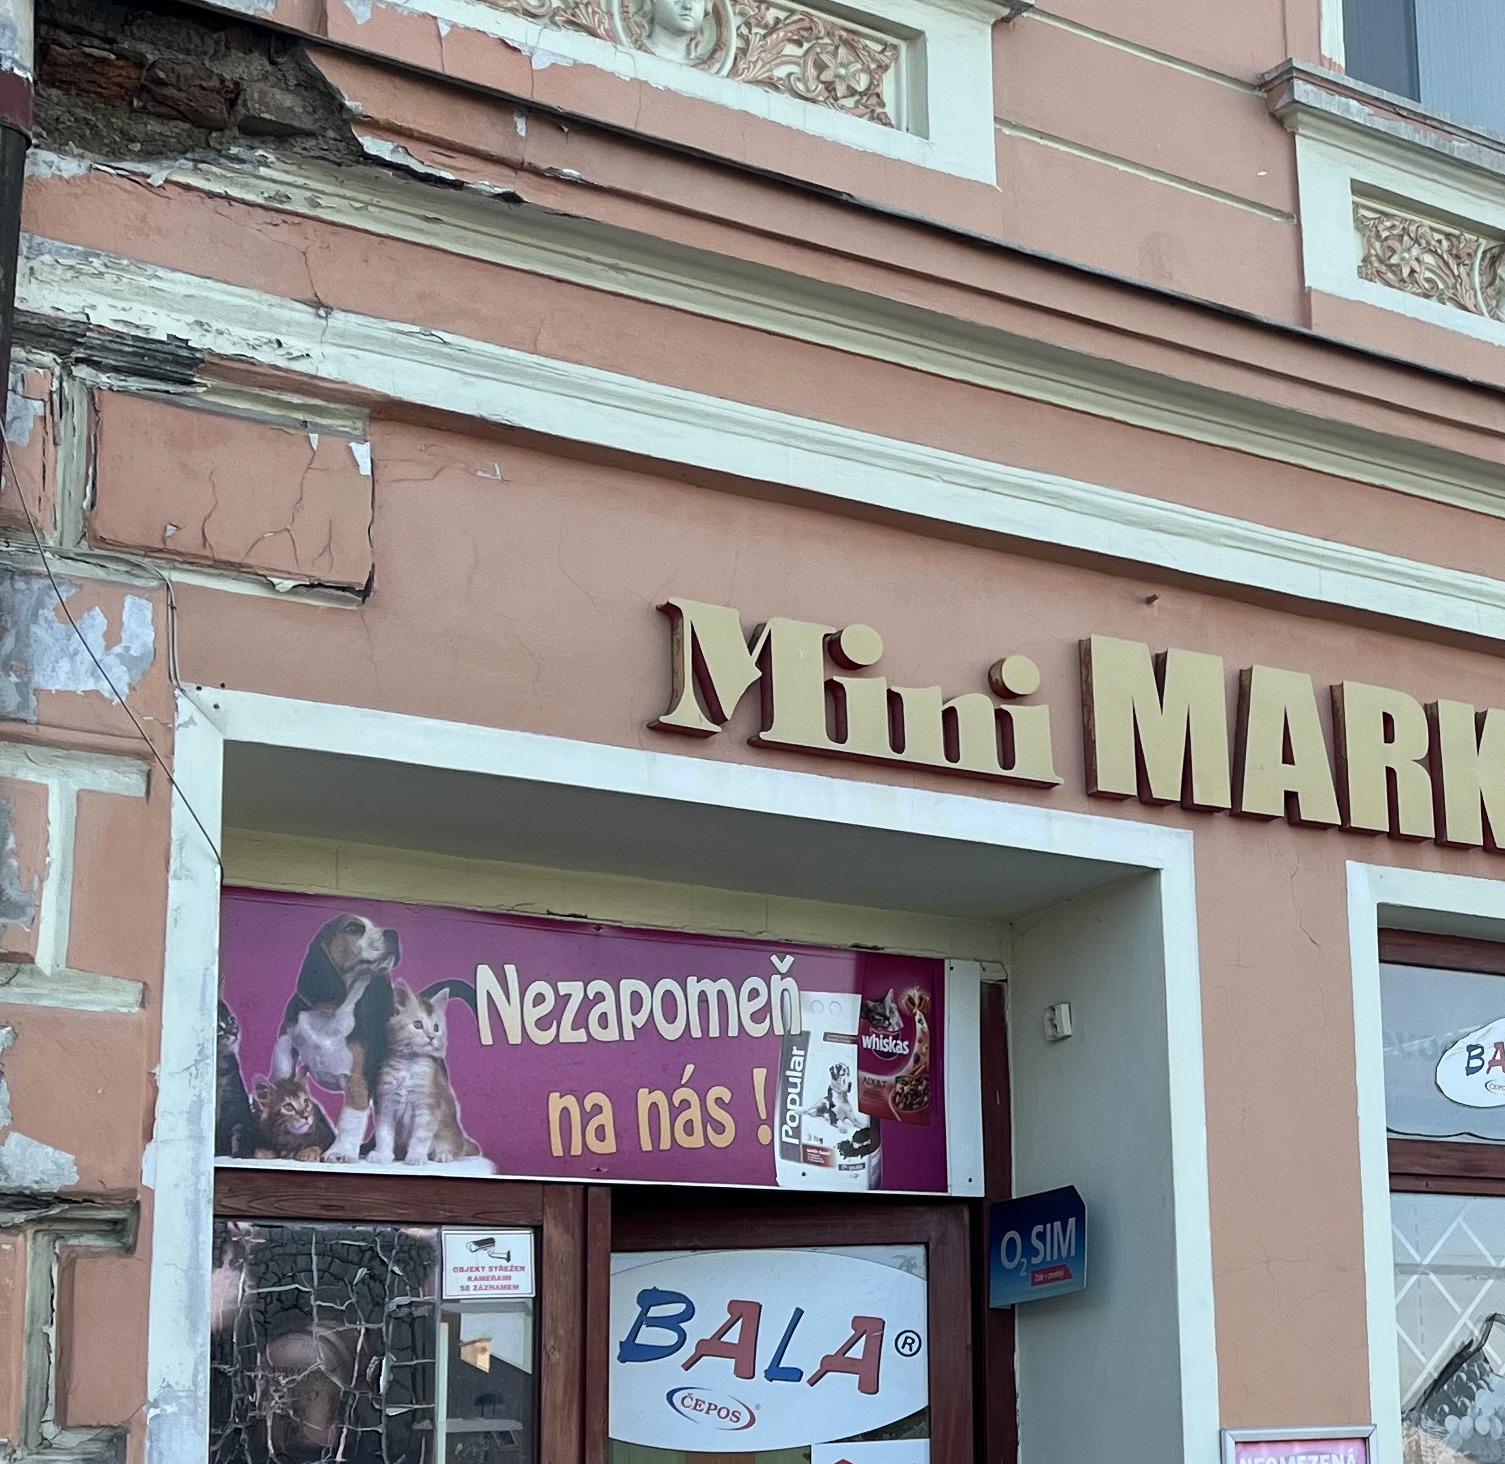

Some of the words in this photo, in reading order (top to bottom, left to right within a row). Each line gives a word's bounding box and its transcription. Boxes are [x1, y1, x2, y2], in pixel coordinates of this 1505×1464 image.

[649, 597, 1064, 788] Mini
[476, 954, 800, 1046] Nezapomeň
[861, 1032, 910, 1056] whiskas
[548, 1089, 617, 1157] na
[638, 1063, 736, 1150] nás
[782, 1046, 806, 1144] Popular
[452, 1265, 486, 1273] OBJEKT
[1031, 1217, 1077, 1265] SIM
[617, 1286, 886, 1395] BALA
[680, 1392, 742, 1423] ČEPOS
